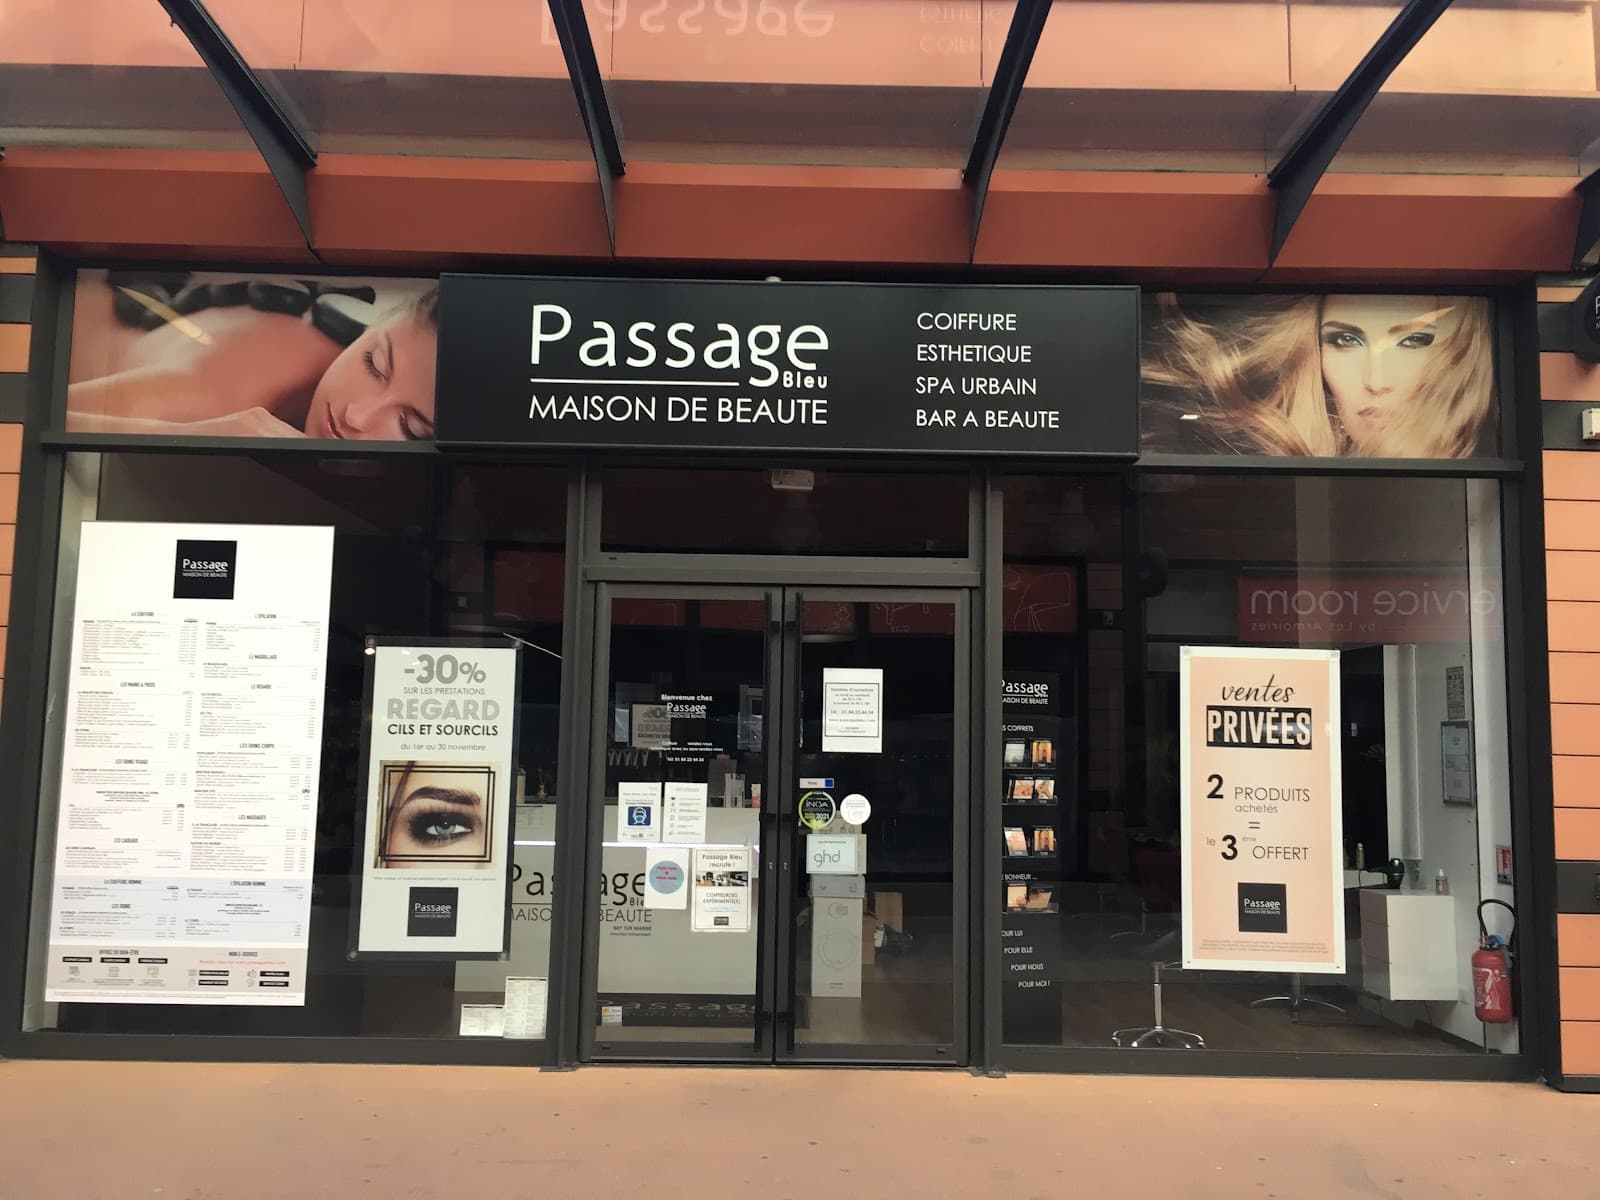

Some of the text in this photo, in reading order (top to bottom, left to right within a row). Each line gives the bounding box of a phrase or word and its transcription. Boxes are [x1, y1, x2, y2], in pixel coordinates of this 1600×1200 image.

[917, 313, 1018, 332] COIFFURE
[530, 304, 830, 388] Passage
[916, 344, 1033, 365] ESTHETIQUE
[782, 371, 828, 389] Bleu
[916, 376, 1037, 397] SPA URBAIN
[529, 396, 828, 425] MAISON DE BEAUTE
[916, 408, 1060, 430] BAR A BEAUTE
[182, 558, 229, 573] Passage
[403, 653, 487, 685] -30%
[403, 686, 486, 696] SUR LES PRESTATIONS
[1221, 673, 1296, 704] ventes
[386, 698, 501, 721] REGARD
[666, 702, 707, 715] Passage
[387, 723, 499, 736] CILS ET SOURCILS
[1207, 707, 1312, 747] PRIVÉES
[400, 743, 487, 752] du 1er au 30 novembre
[1206, 773, 1311, 802] 2 PRODUITS
[1234, 802, 1279, 814] achetés
[1206, 836, 1217, 847] le
[1220, 834, 1239, 861] 3
[1252, 845, 1309, 861] OFFERT
[813, 849, 841, 868] ghd
[414, 903, 452, 914] Passage
[1243, 898, 1281, 910] Passage
